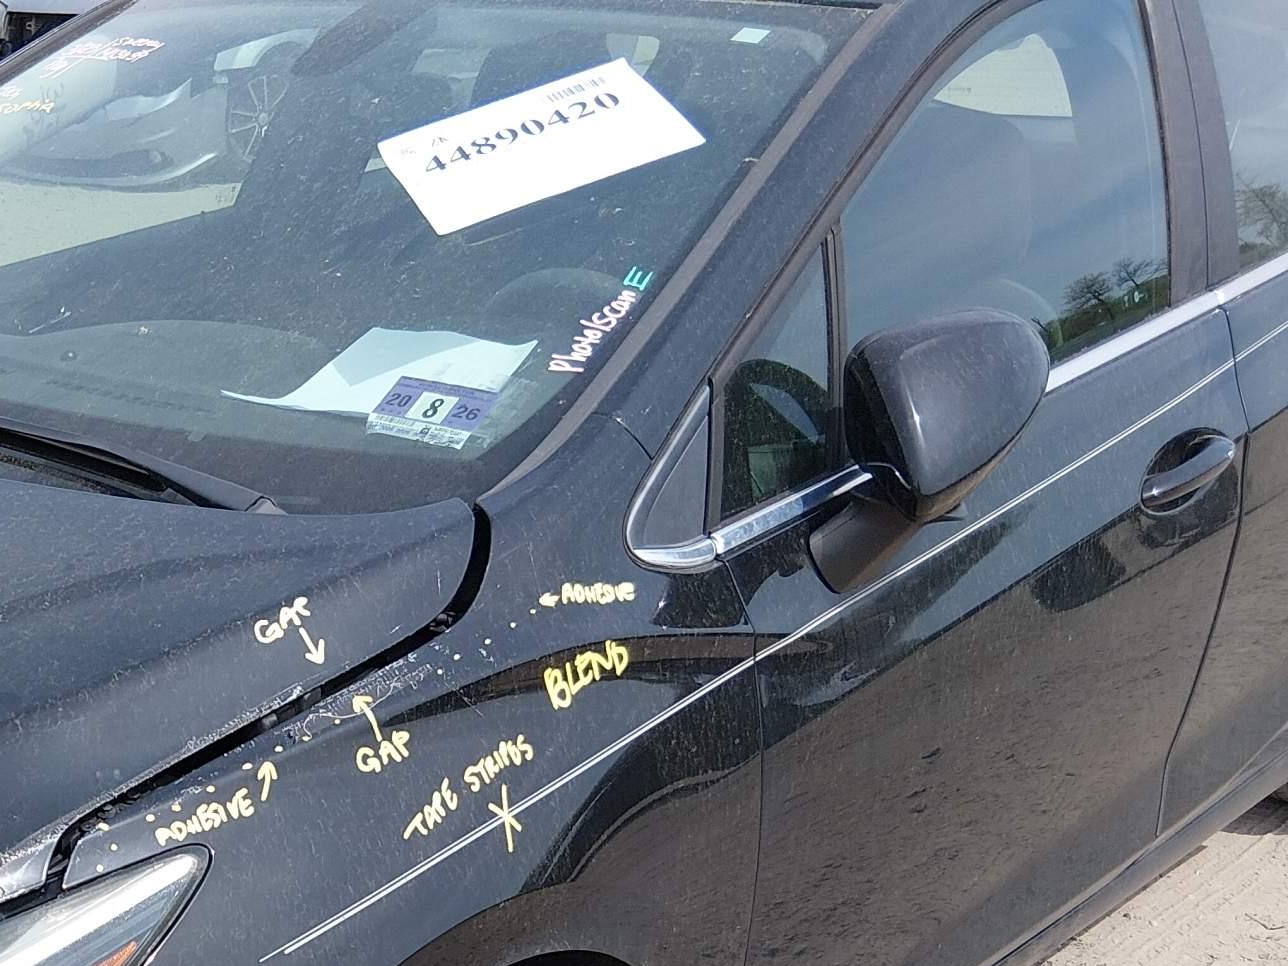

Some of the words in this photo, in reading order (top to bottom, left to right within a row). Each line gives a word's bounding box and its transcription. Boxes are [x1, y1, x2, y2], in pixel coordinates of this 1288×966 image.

[425, 92, 620, 173] 44890420
[385, 392, 412, 408] 20
[421, 398, 445, 419] 8
[452, 404, 481, 421] 26
[543, 639, 629, 710] BLEND
[355, 730, 411, 773] GAP
[154, 787, 256, 846] ADHESIVE
[403, 776, 458, 840] TAPE
